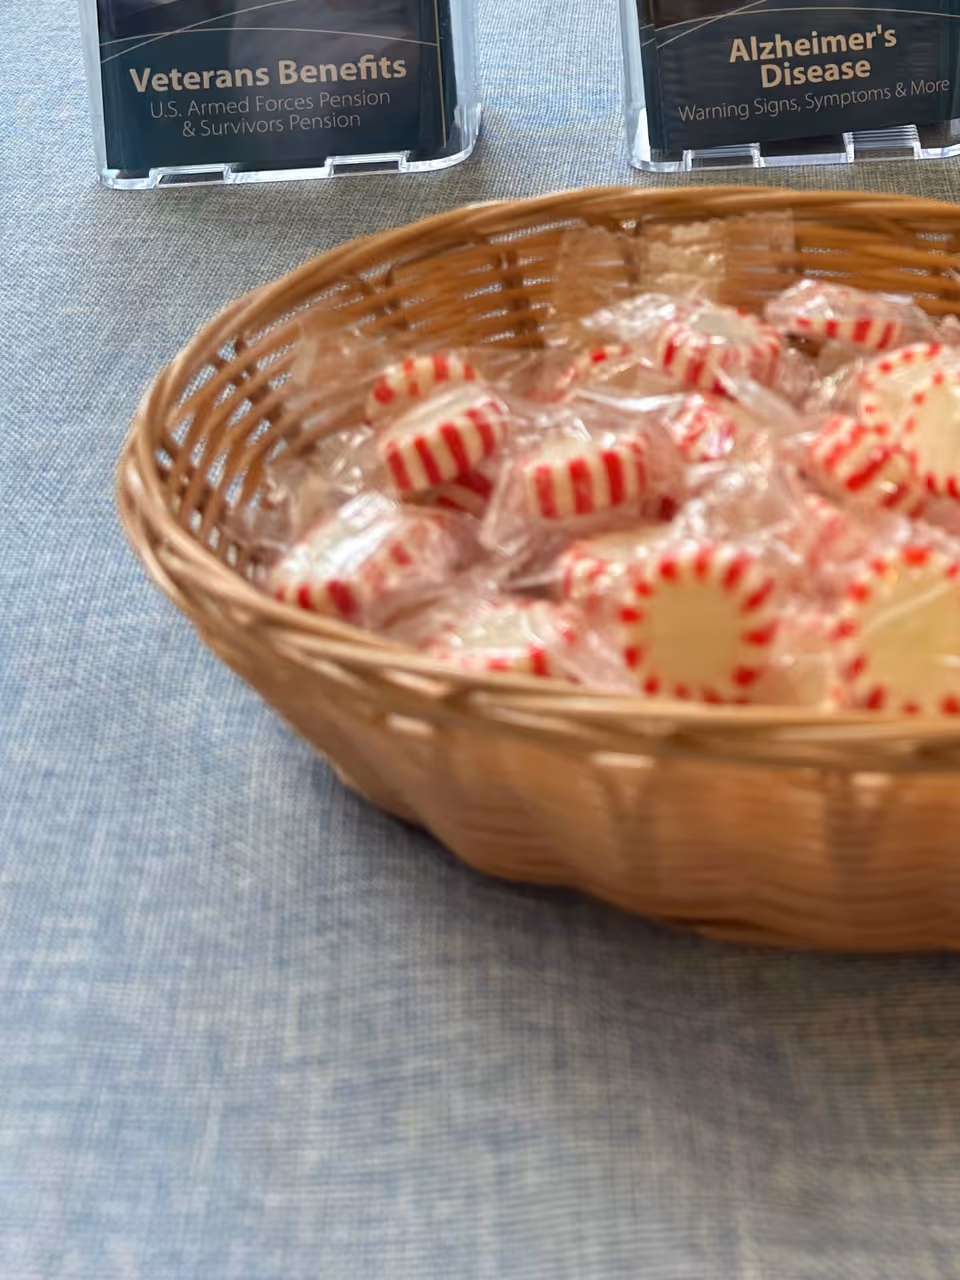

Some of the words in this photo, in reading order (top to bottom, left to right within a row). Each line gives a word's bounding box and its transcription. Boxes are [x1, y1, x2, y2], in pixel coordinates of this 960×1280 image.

[728, 24, 898, 63] Alzheimer's
[129, 66, 270, 93] Veterans
[278, 53, 407, 85] Benefits
[760, 58, 872, 89] Disease
[150, 100, 183, 118] U.S.
[188, 96, 250, 116] Armed
[255, 92, 314, 113] Forces
[319, 88, 391, 108] Pension
[678, 101, 750, 122] Warning
[754, 96, 802, 118] Signs,
[805, 86, 892, 110] Symptoms
[895, 83, 907, 97] &
[910, 77, 951, 94] More
[182, 121, 196, 138] &
[200, 116, 285, 138] Survivors
[289, 112, 361, 132] Pension
